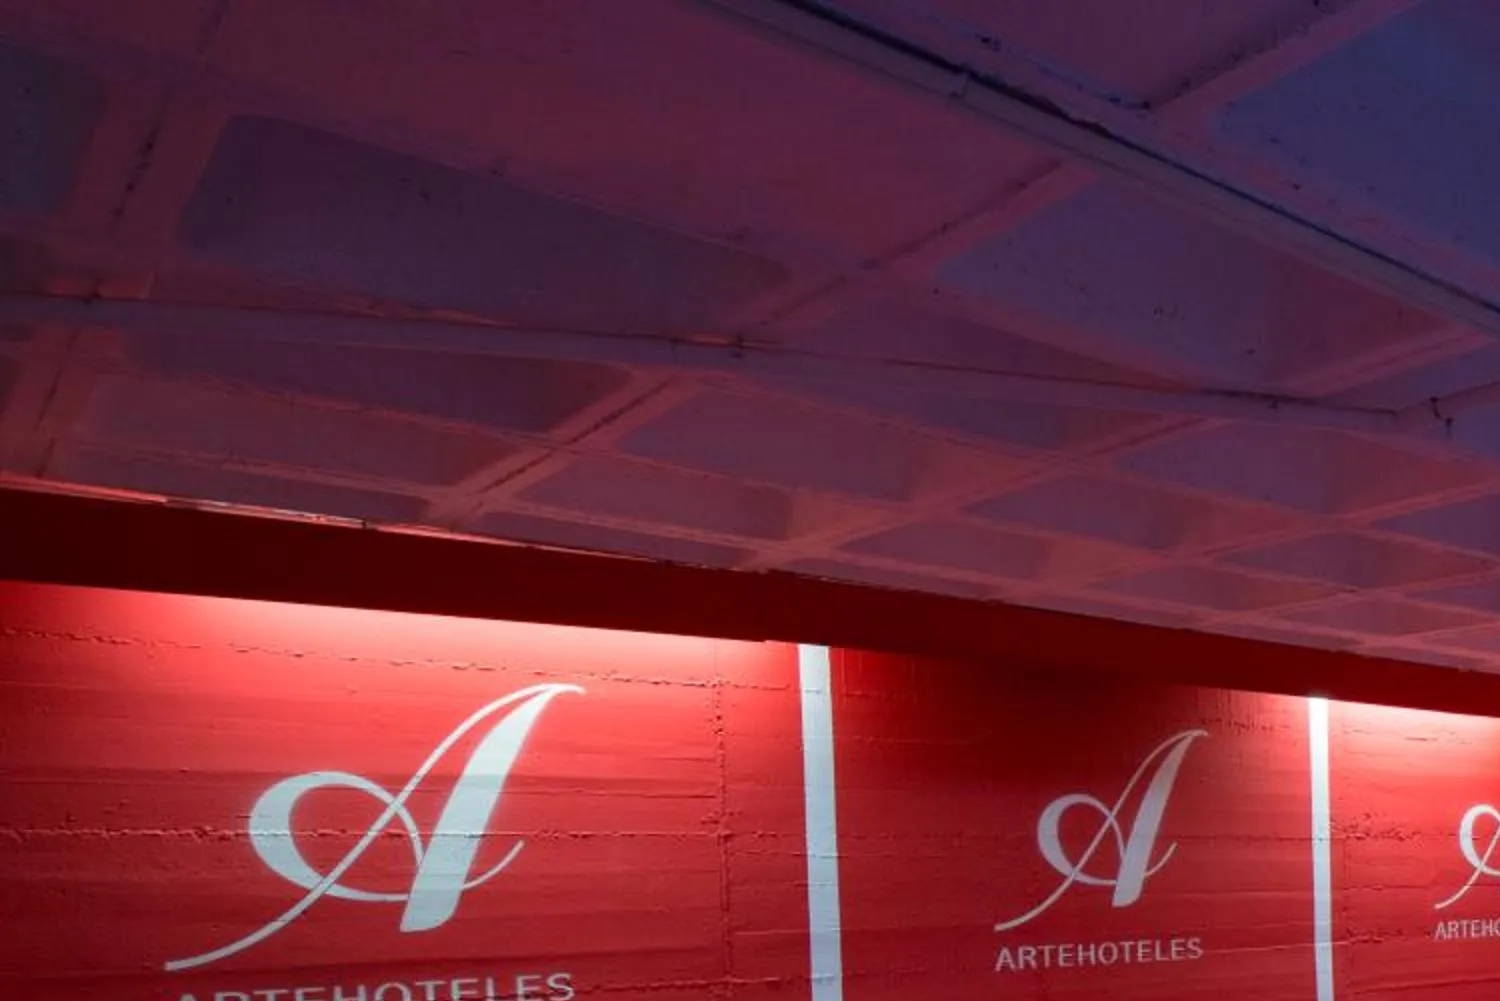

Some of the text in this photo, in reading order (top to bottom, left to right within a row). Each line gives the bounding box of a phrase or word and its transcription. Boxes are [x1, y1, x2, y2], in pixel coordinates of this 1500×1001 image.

[163, 682, 587, 973] A
[993, 728, 1209, 932] A
[993, 936, 1204, 973] ARTEHOTELES
